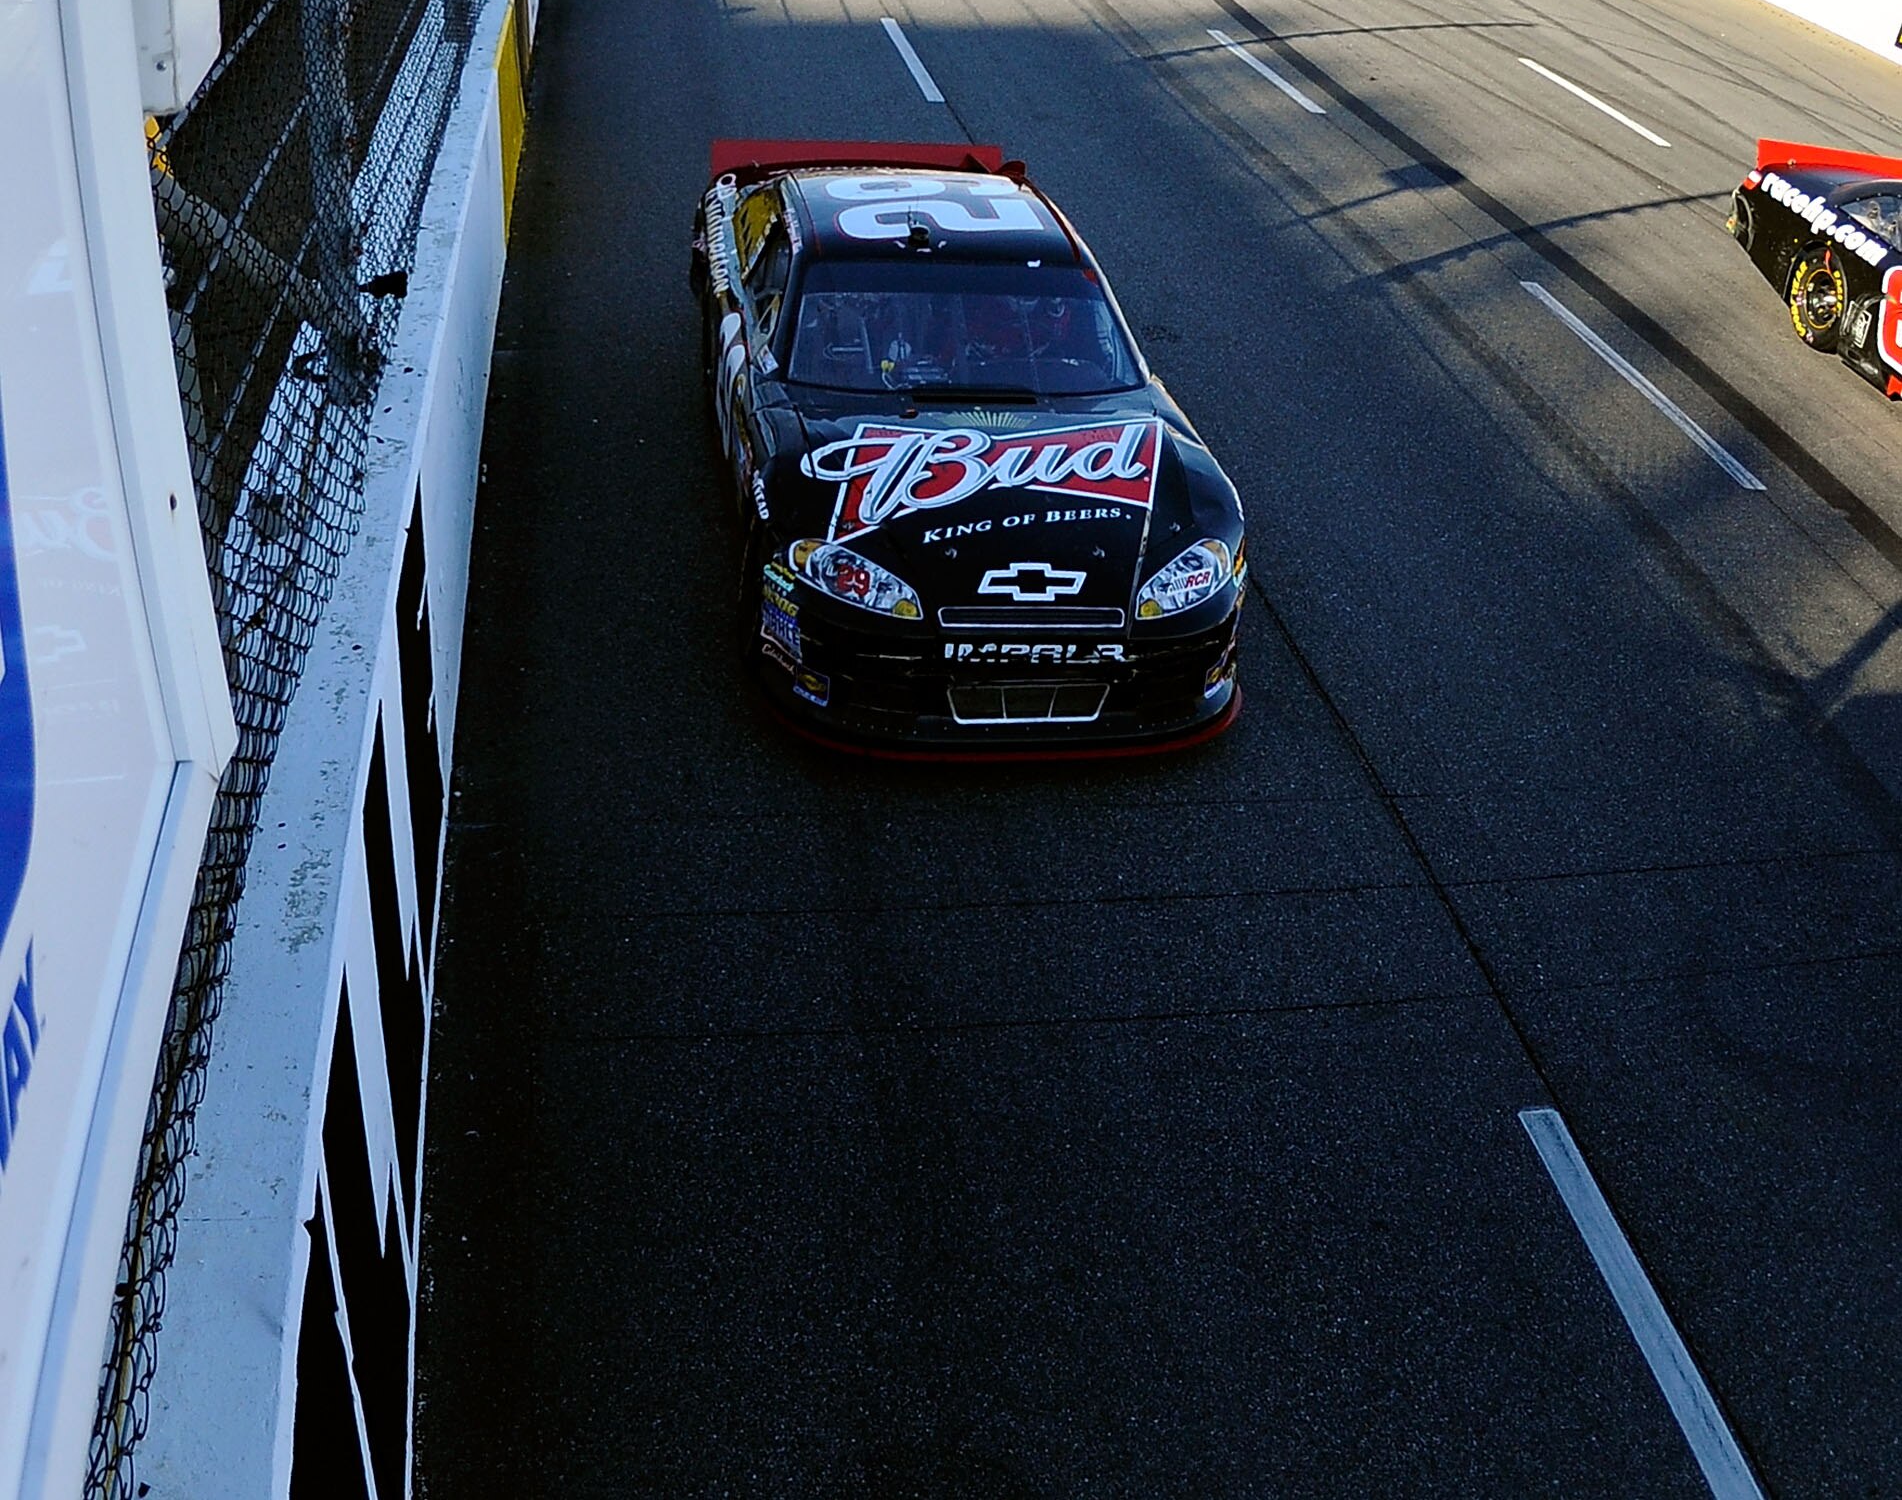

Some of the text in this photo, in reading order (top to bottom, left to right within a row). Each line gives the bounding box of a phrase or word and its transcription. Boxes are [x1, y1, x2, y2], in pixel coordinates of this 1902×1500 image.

[1761, 172, 1888, 267] racehp.com
[800, 421, 1149, 524] Bud
[922, 519, 993, 544] KING
[1002, 513, 1037, 528] OF
[837, 564, 872, 598] 29
[1186, 571, 1212, 589] RCR
[944, 642, 1126, 664] IMPALA
